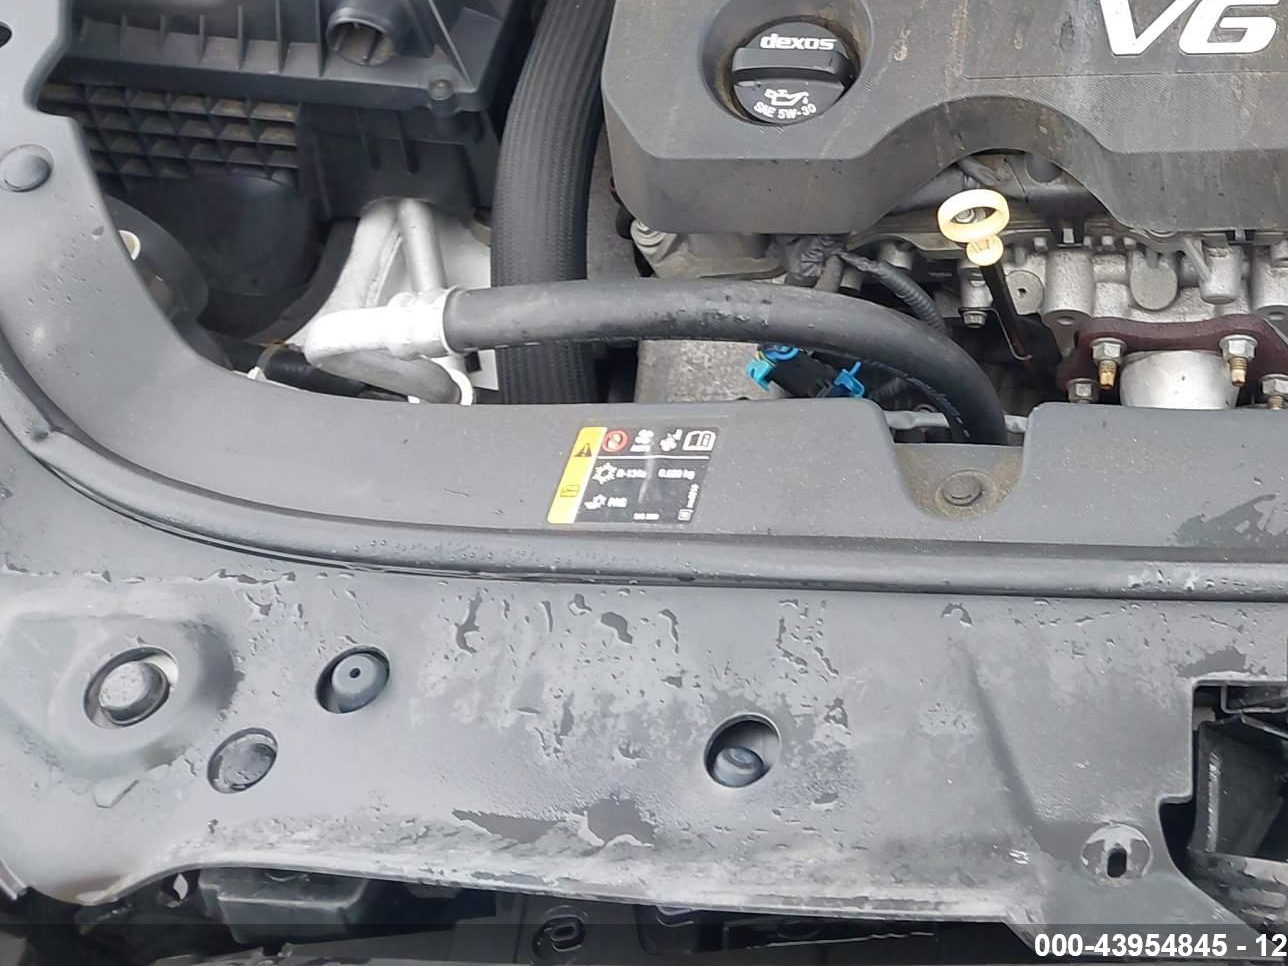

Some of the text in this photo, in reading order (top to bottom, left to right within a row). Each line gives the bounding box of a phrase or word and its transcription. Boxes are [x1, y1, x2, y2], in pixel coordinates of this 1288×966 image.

[760, 34, 836, 50] dexos
[754, 100, 816, 119] SAE 5W-30
